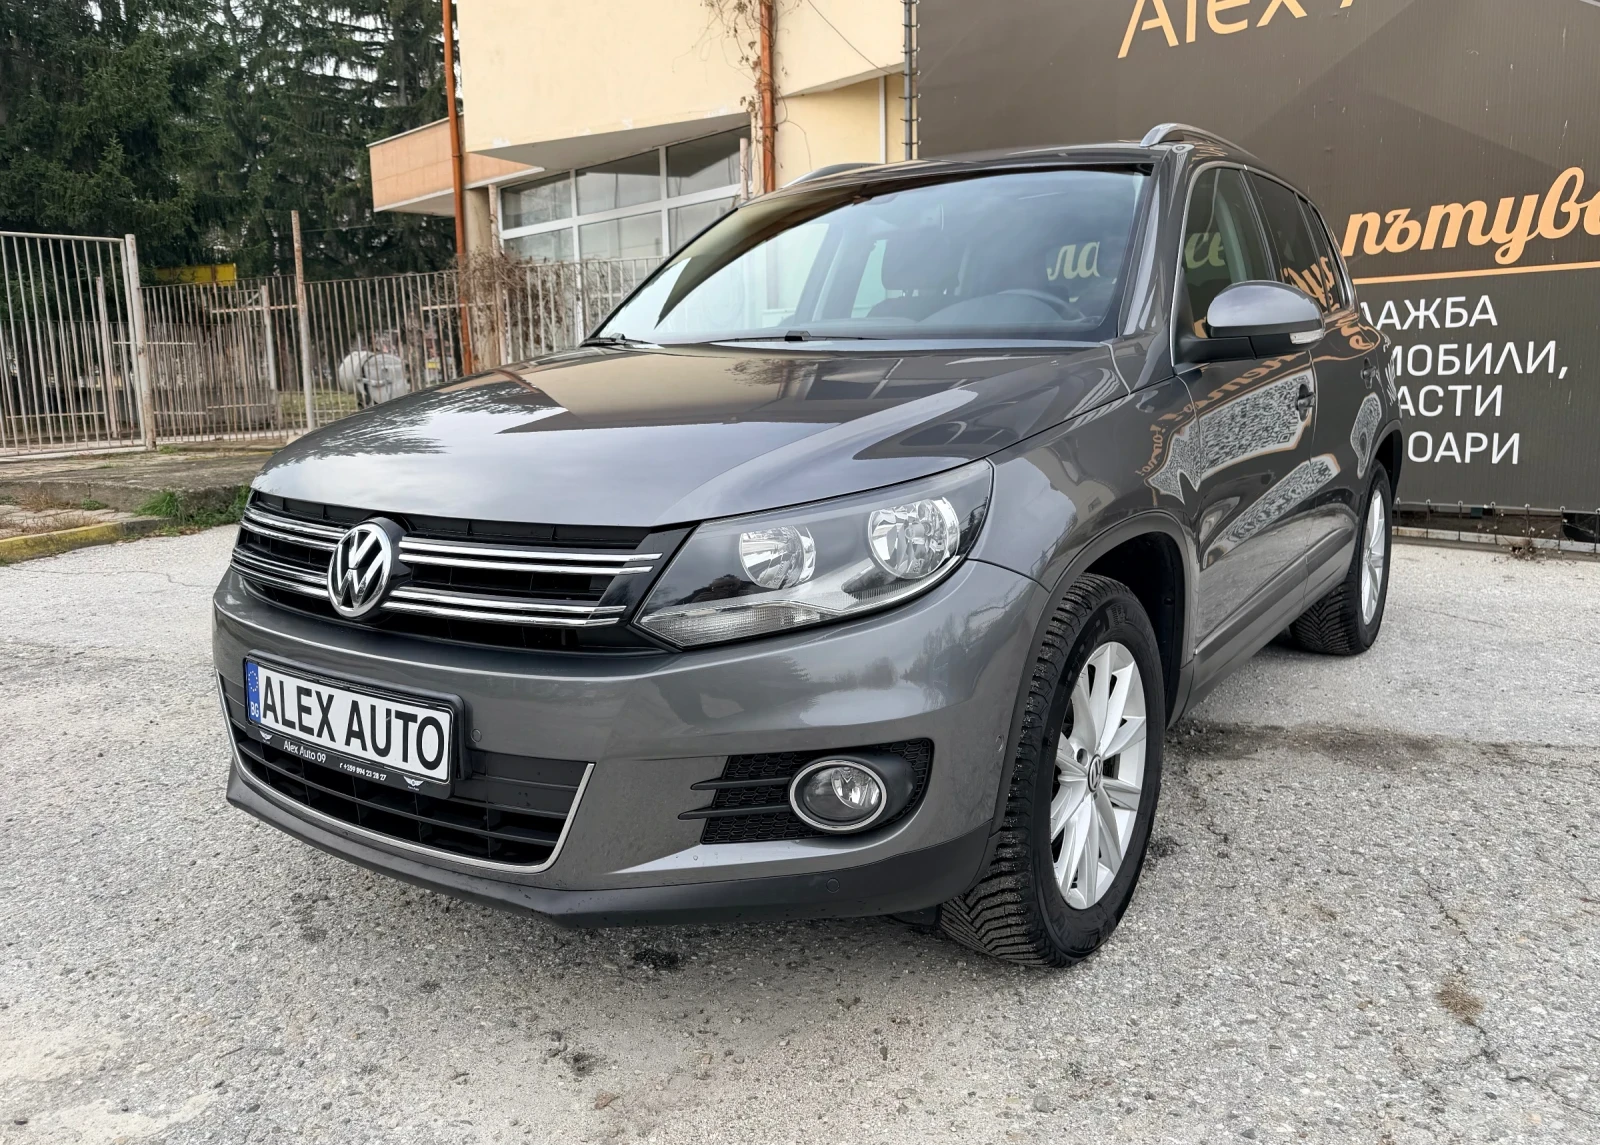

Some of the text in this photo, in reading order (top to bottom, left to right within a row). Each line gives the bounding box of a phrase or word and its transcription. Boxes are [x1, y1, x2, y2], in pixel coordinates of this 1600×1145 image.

[1407, 430, 1520, 465] ОАРИ
[250, 701, 260, 718] BG
[262, 675, 445, 771] ALEX AUTO
[283, 740, 327, 764] Alex Auto 09
